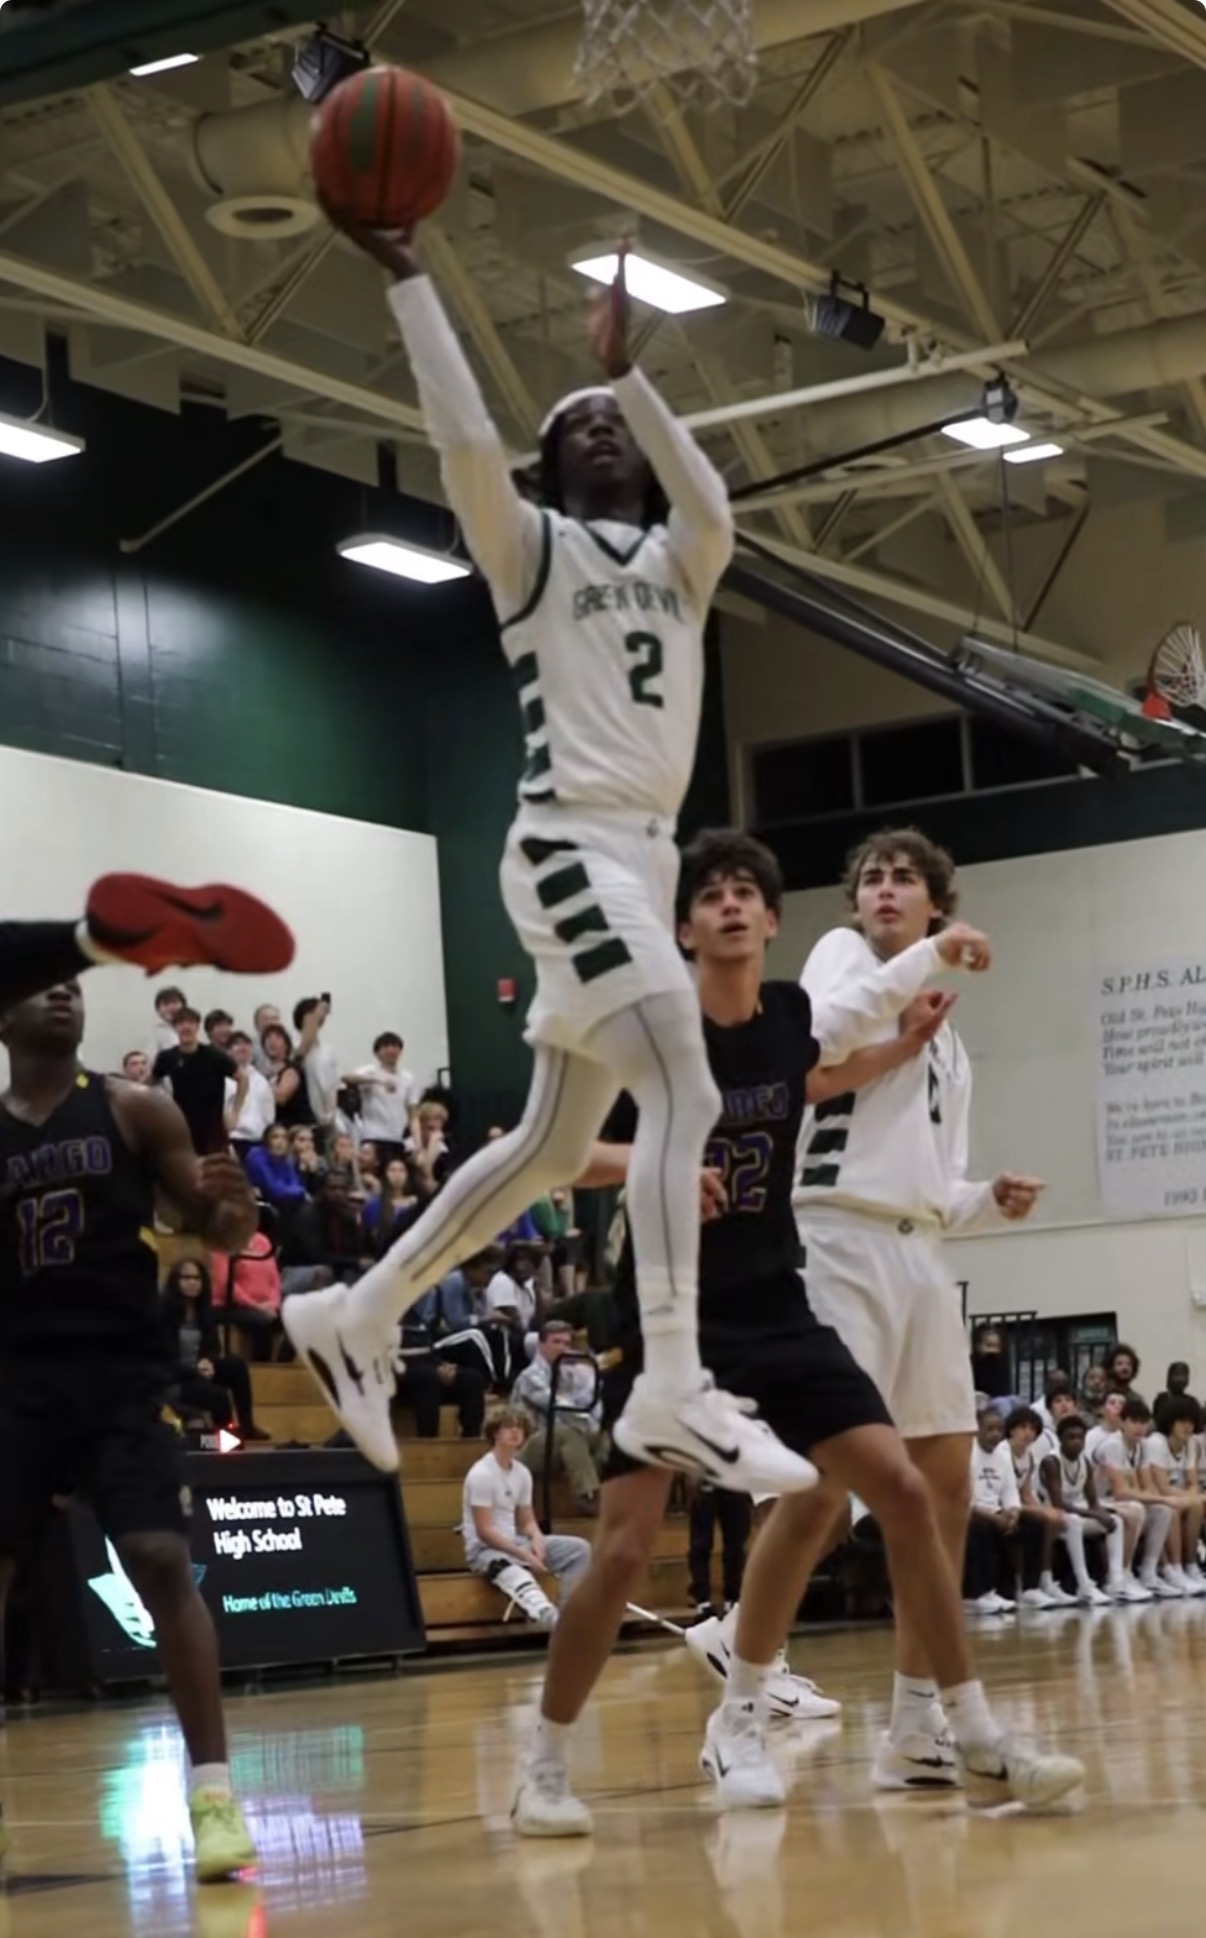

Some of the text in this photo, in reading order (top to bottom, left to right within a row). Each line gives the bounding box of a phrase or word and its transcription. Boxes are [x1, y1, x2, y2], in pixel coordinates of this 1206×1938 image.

[625, 631, 665, 709] 2
[6, 1134, 113, 1190] ARGO
[16, 1187, 86, 1278] 12
[206, 1493, 347, 1521] Welcome to St Pete
[213, 1526, 303, 1560] High School
[222, 1595, 258, 1613] Home
[258, 1592, 271, 1611] of
[271, 1592, 292, 1609] the
[292, 1590, 325, 1608] Green
